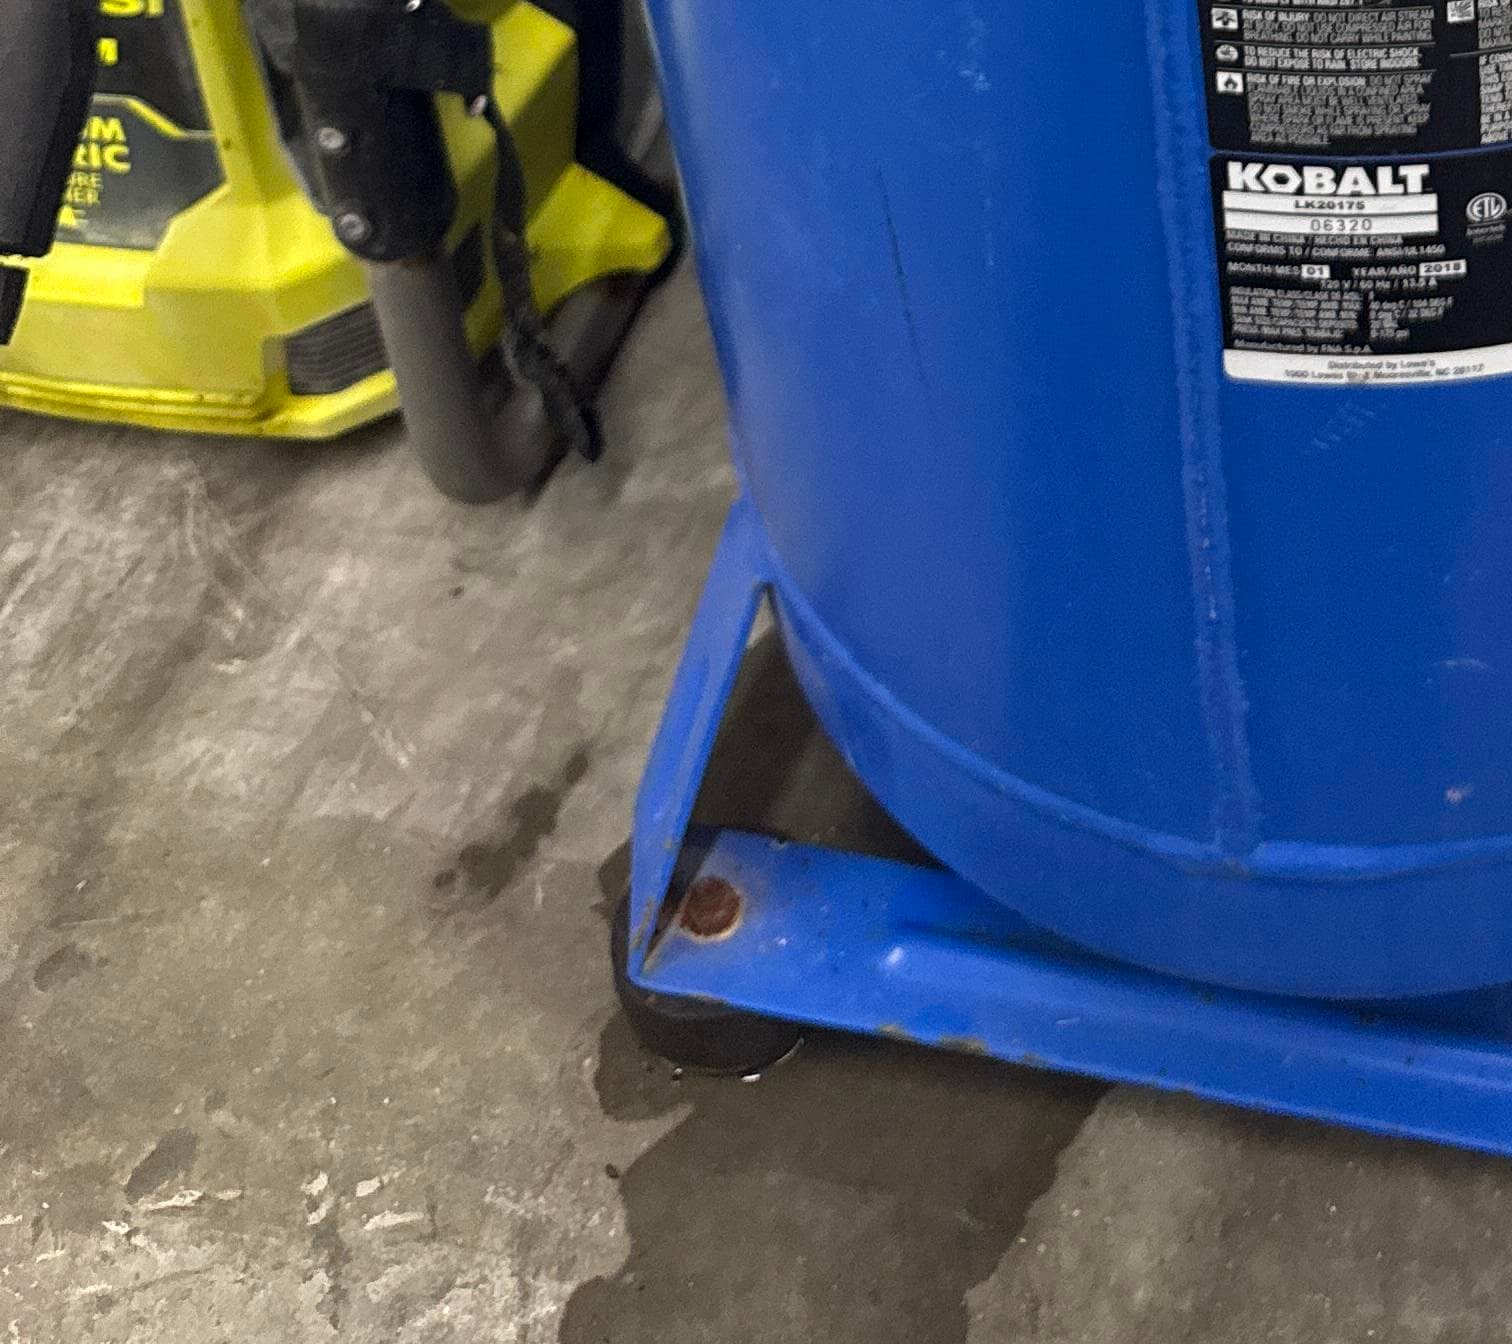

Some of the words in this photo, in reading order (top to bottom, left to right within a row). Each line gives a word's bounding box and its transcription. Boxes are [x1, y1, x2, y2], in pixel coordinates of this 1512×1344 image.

[1227, 161, 1430, 195] KOBALT
[1294, 199, 1366, 210] LK20175
[1310, 218, 1373, 232] 06320
[1306, 265, 1324, 276] 01
[1423, 262, 1462, 273] 2018
